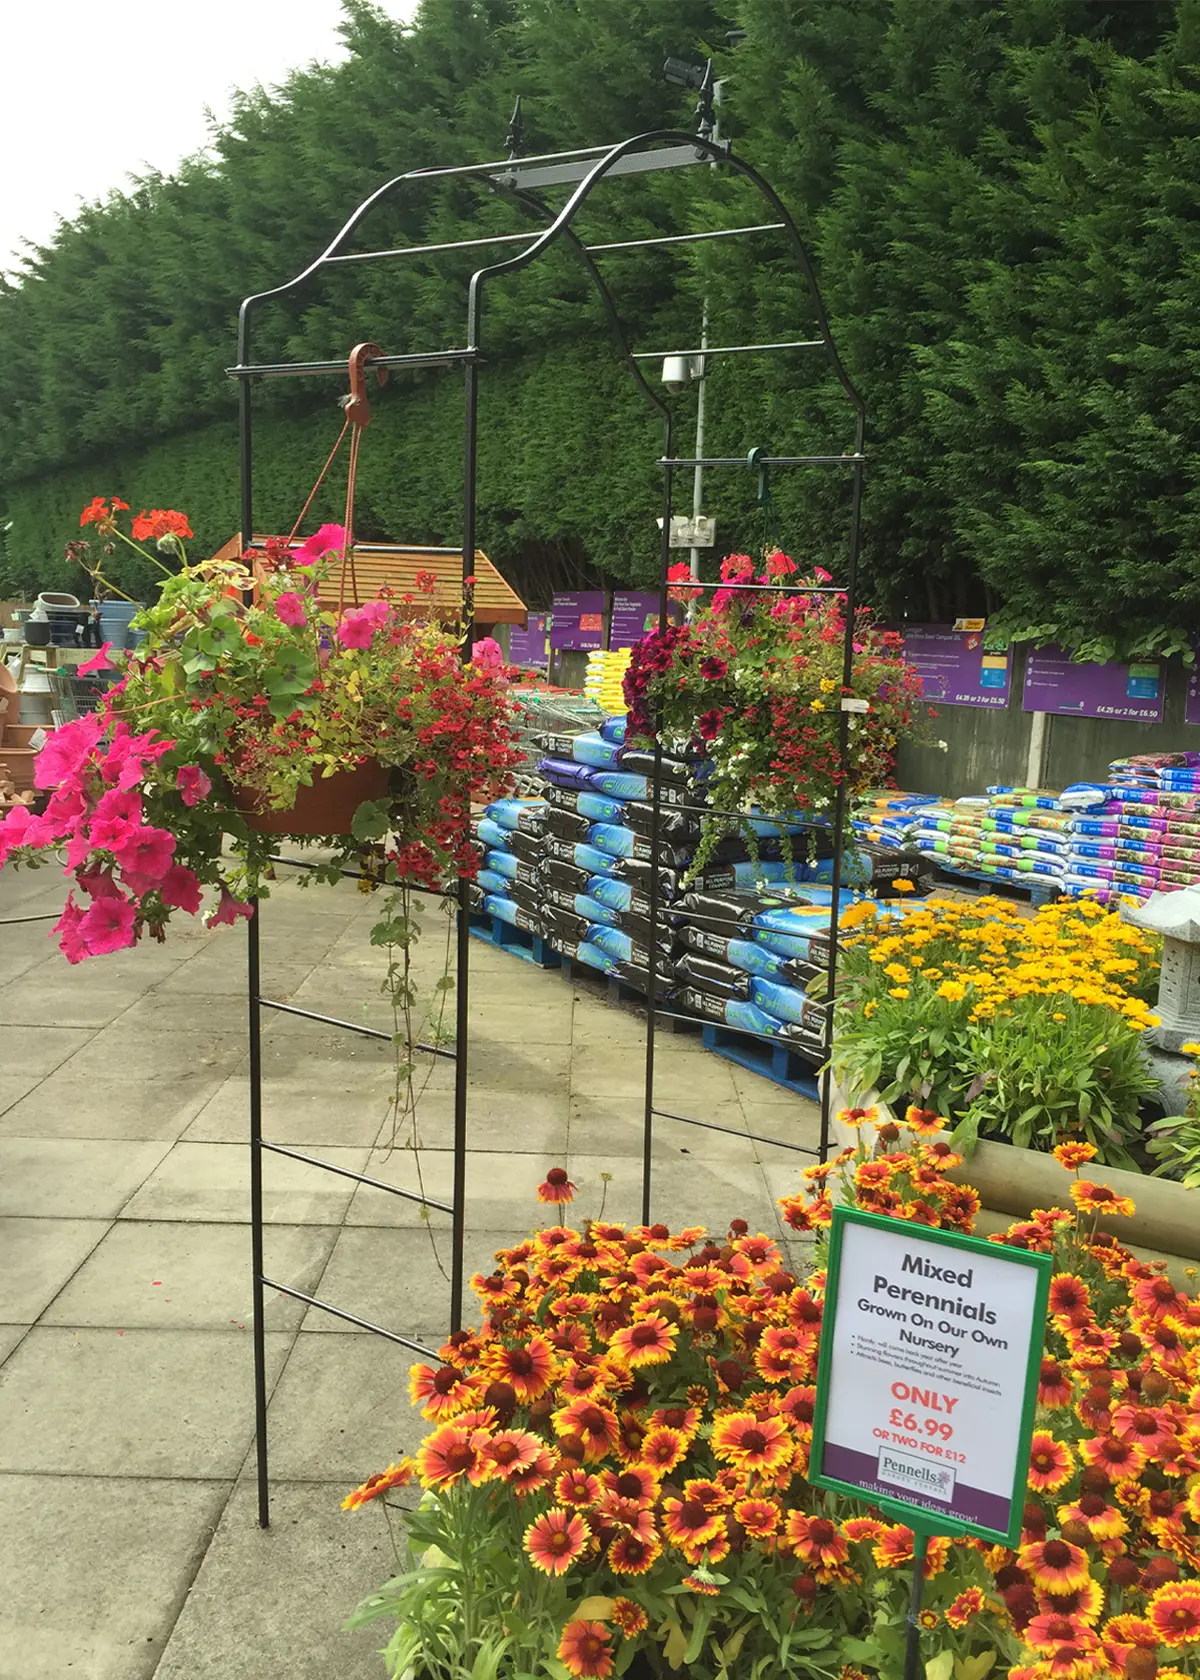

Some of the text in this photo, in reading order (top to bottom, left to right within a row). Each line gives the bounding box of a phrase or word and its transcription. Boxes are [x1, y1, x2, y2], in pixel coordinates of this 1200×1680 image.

[1128, 708, 1138, 716] for
[901, 1254, 973, 1288] Mixed
[873, 1275, 997, 1325] Perennials
[858, 1298, 1008, 1350] Grown On Our Own
[900, 1329, 959, 1358] Nursery
[905, 1348, 919, 1356] back
[856, 1352, 876, 1361] Attracts
[894, 1361, 922, 1374] butterflies
[923, 1370, 935, 1378] and
[952, 1379, 981, 1390] beneficial
[982, 1386, 1001, 1396] insects
[857, 1343, 882, 1355] Stunning
[883, 1350, 903, 1360] flowers
[904, 1356, 937, 1370] throughout
[938, 1367, 962, 1376] summer
[963, 1372, 975, 1380] into
[891, 1382, 959, 1414] ONLY
[889, 1408, 953, 1440] £6.99
[872, 1428, 966, 1464] OR TWO FOR £12
[883, 1458, 937, 1483] Pennells
[897, 1493, 919, 1505] your
[921, 1500, 946, 1514] ideas
[949, 1509, 978, 1523] grow!
